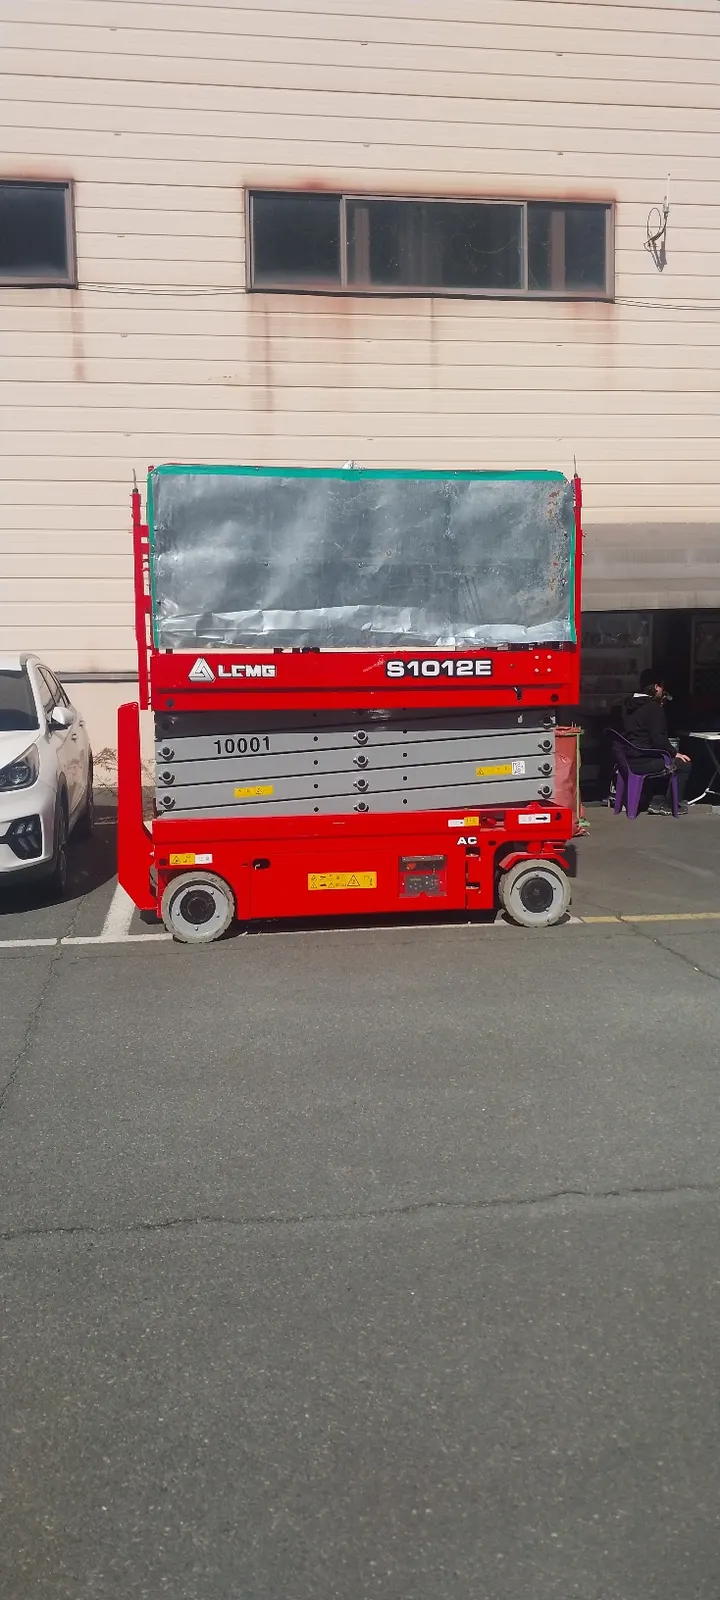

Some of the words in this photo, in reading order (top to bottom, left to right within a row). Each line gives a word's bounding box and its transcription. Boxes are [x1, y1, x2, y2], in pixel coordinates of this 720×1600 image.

[386, 660, 492, 677] S1012E
[214, 736, 270, 754] 10001
[457, 837, 477, 845] AC
